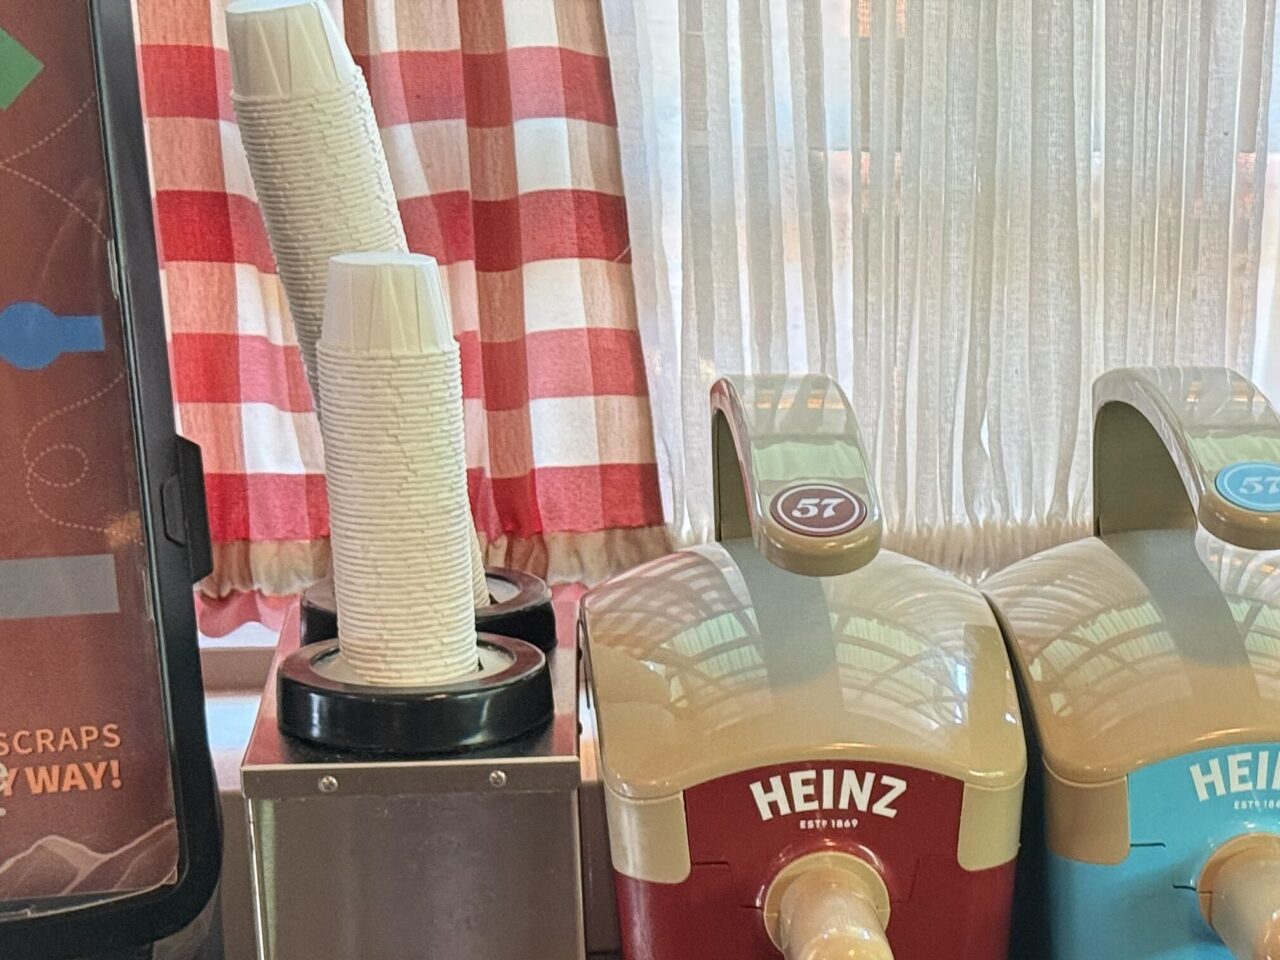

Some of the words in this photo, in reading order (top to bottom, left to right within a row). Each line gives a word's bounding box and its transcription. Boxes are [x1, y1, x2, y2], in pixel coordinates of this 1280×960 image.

[791, 497, 847, 519] 57
[24, 759, 123, 795] WAY!
[749, 768, 908, 822] HEINZ
